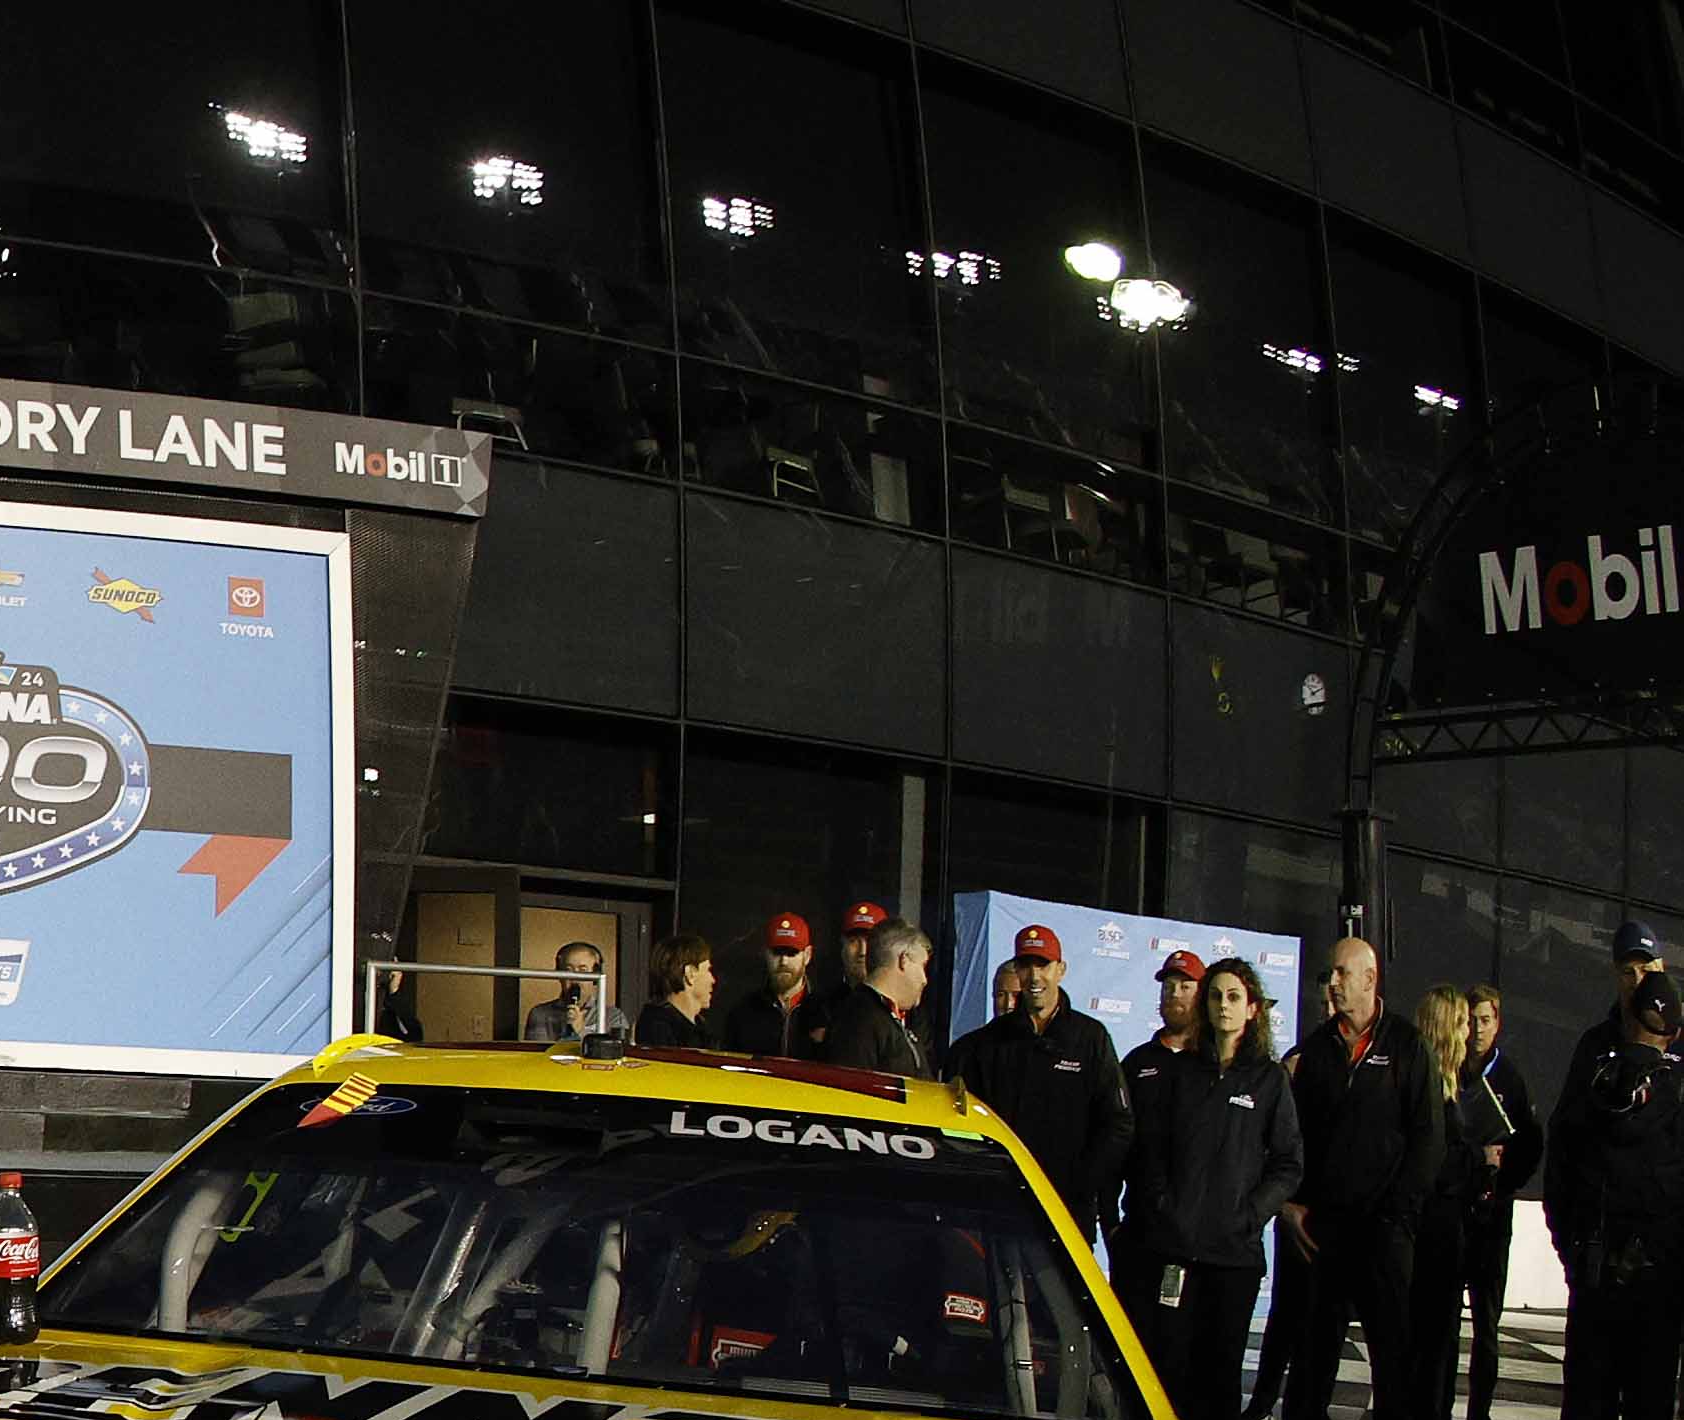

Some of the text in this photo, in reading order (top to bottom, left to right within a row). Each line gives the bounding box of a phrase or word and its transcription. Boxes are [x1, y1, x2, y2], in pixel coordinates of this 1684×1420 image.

[118, 410, 287, 475] LANE
[334, 443, 426, 485] Mobil
[89, 585, 162, 607] SUNOCO
[1478, 524, 1680, 634] Mobil
[220, 622, 275, 639] TOYOTA
[20, 671, 45, 687] 24
[669, 1111, 936, 1160] LOGANO
